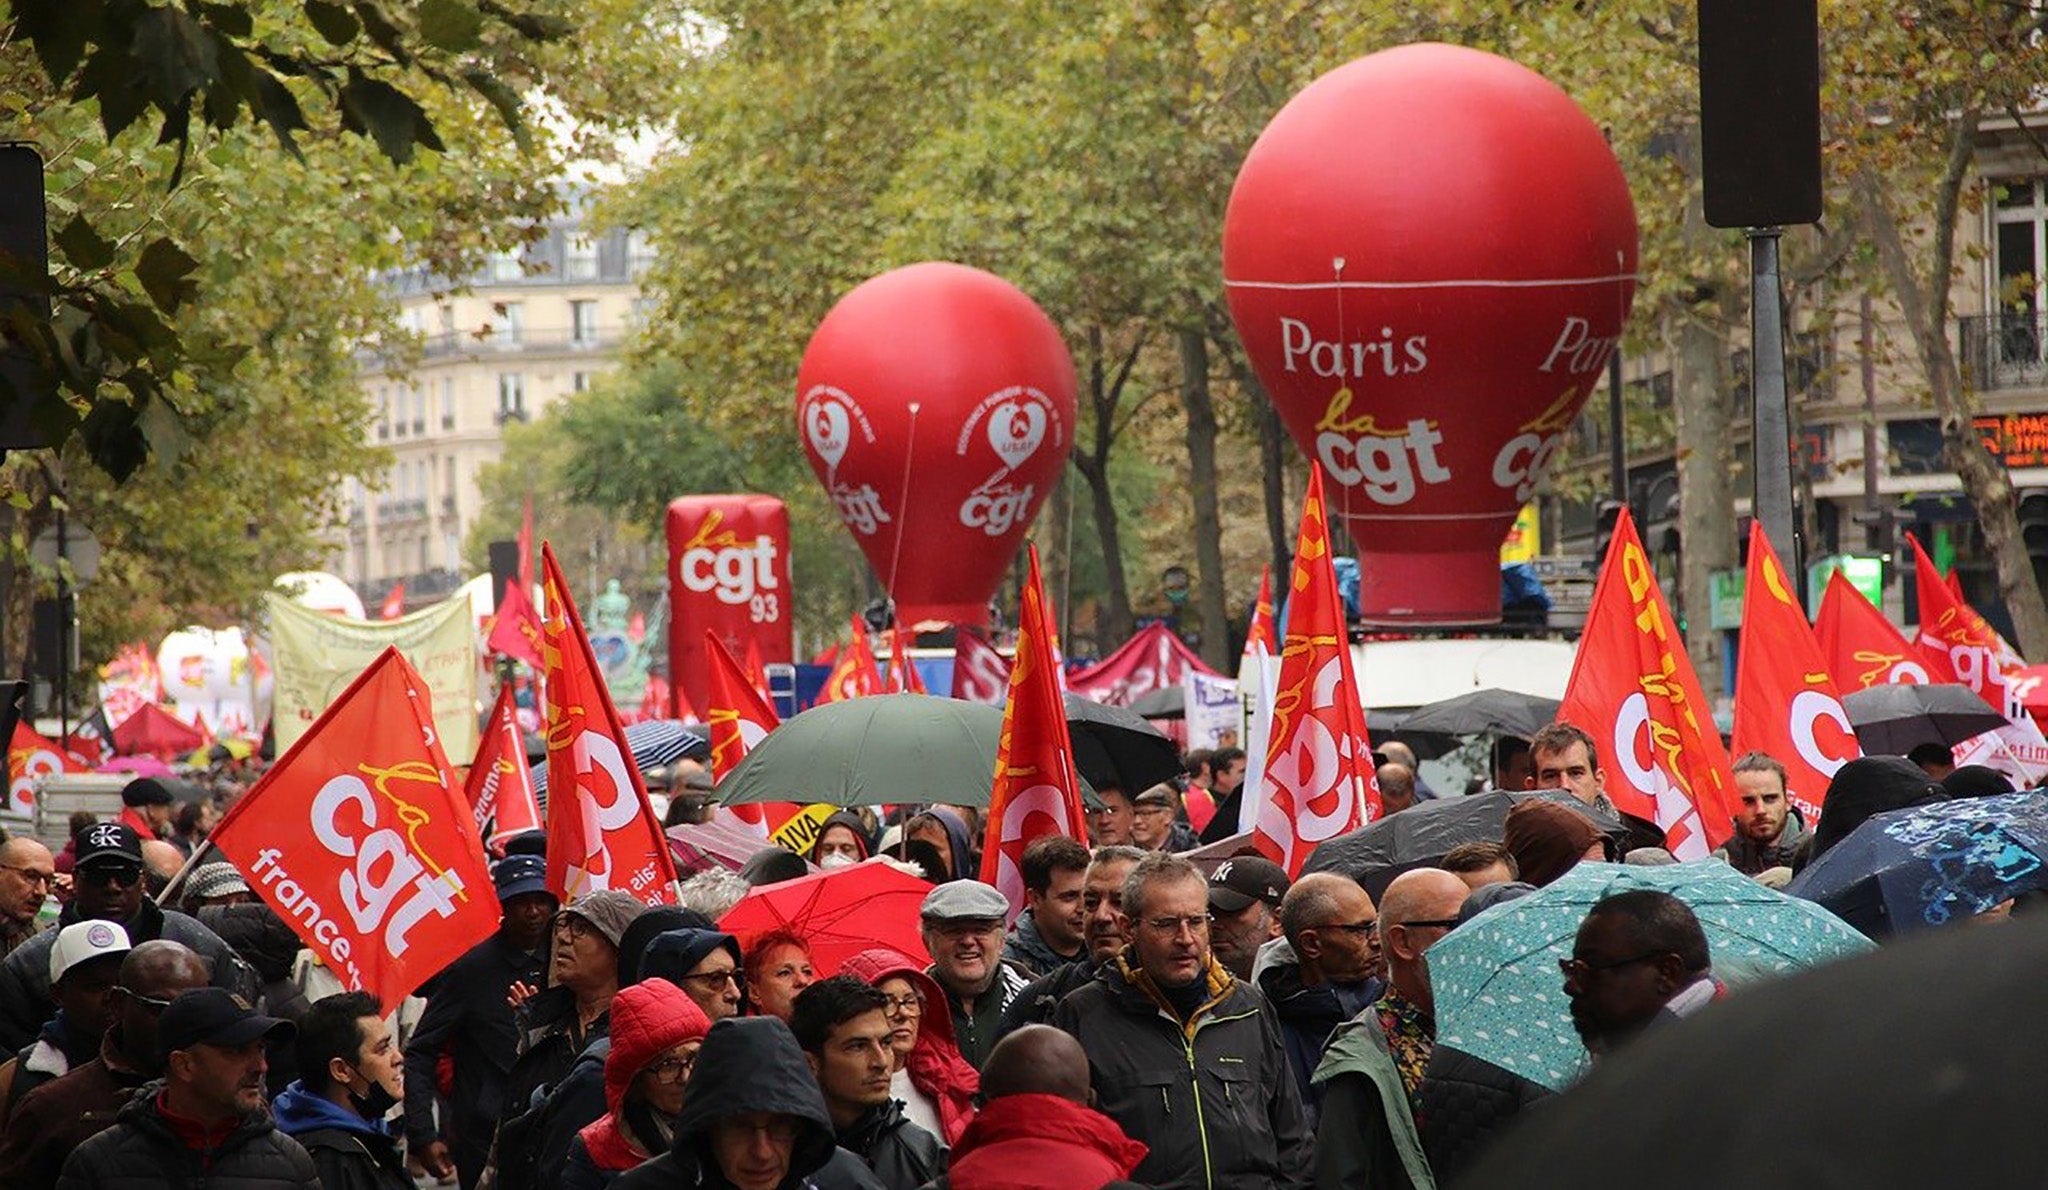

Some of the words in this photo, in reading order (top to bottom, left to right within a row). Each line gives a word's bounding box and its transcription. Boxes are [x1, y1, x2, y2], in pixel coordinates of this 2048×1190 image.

[1280, 316, 1427, 378] Paris
[1315, 387, 1438, 438] la
[1317, 418, 1451, 506] cgt
[684, 508, 774, 549] la
[960, 484, 1033, 535] cgt
[681, 535, 778, 604] cgt
[750, 593, 779, 623] 93
[358, 762, 468, 903] la
[311, 774, 465, 959] cgt
[250, 848, 351, 963] france
